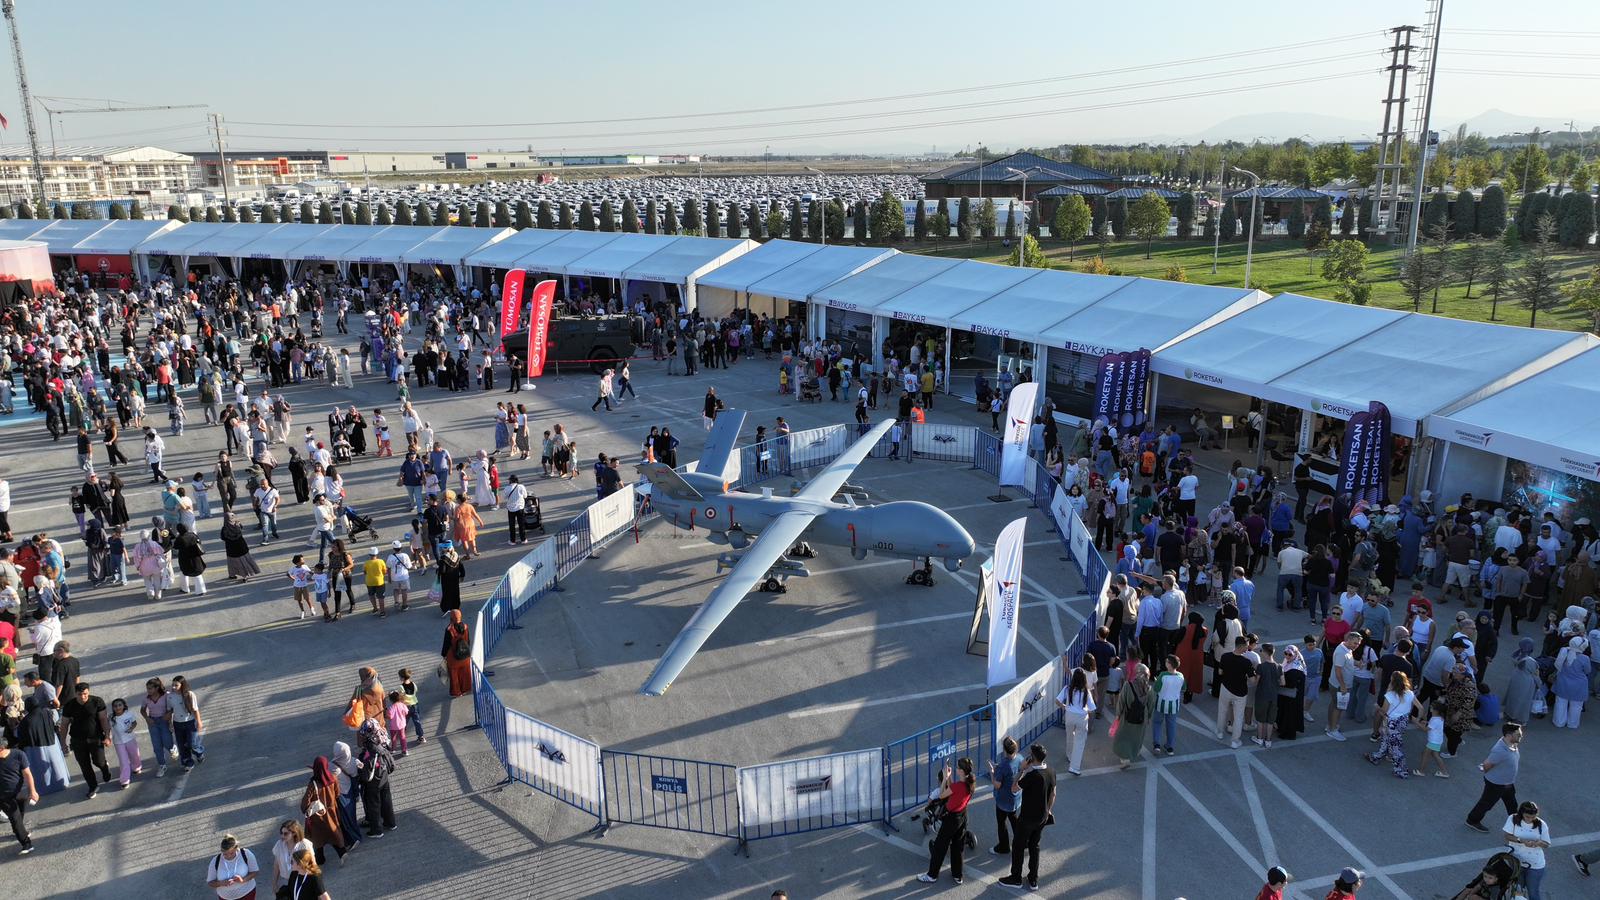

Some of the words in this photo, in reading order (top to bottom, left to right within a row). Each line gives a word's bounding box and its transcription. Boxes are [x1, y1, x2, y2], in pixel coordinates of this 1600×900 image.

[832, 300, 857, 311] BAYKAR
[898, 312, 926, 323] BAYKAR
[976, 325, 1010, 338] BAYKAR
[1125, 360, 1137, 410] ROKETSAN
[1193, 371, 1223, 385] ROKETSAN
[1100, 362, 1114, 412] ROKETSAN
[1322, 403, 1357, 417] ROKETSA
[1345, 424, 1363, 489] ROKETSAN
[656, 783, 682, 793] POLİS
